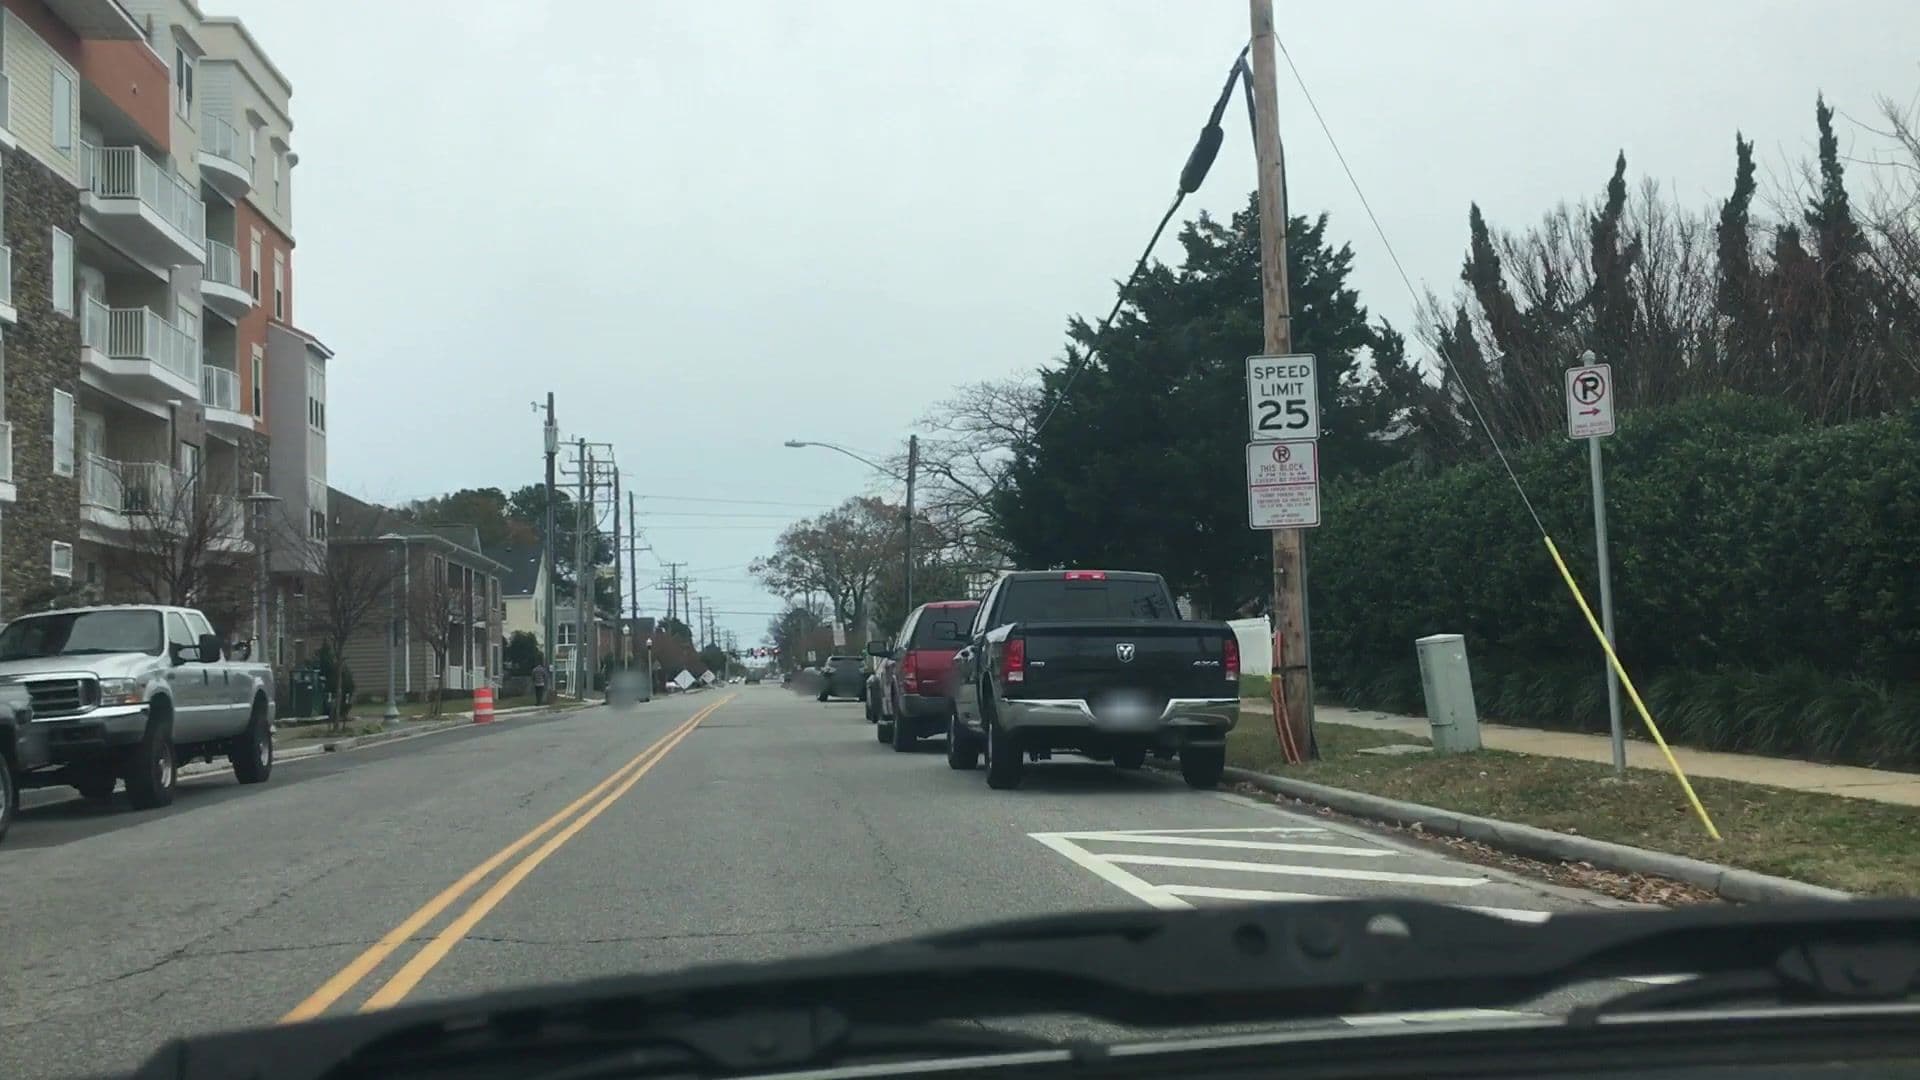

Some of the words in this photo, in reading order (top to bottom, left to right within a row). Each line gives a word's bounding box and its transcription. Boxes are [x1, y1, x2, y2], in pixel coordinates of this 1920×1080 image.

[1254, 365, 1310, 380] SPEED
[1260, 383, 1304, 397] LIMIT
[1257, 399, 1310, 430] 25
[1260, 464, 1276, 473] THIS
[1279, 463, 1304, 472] BLOCK
